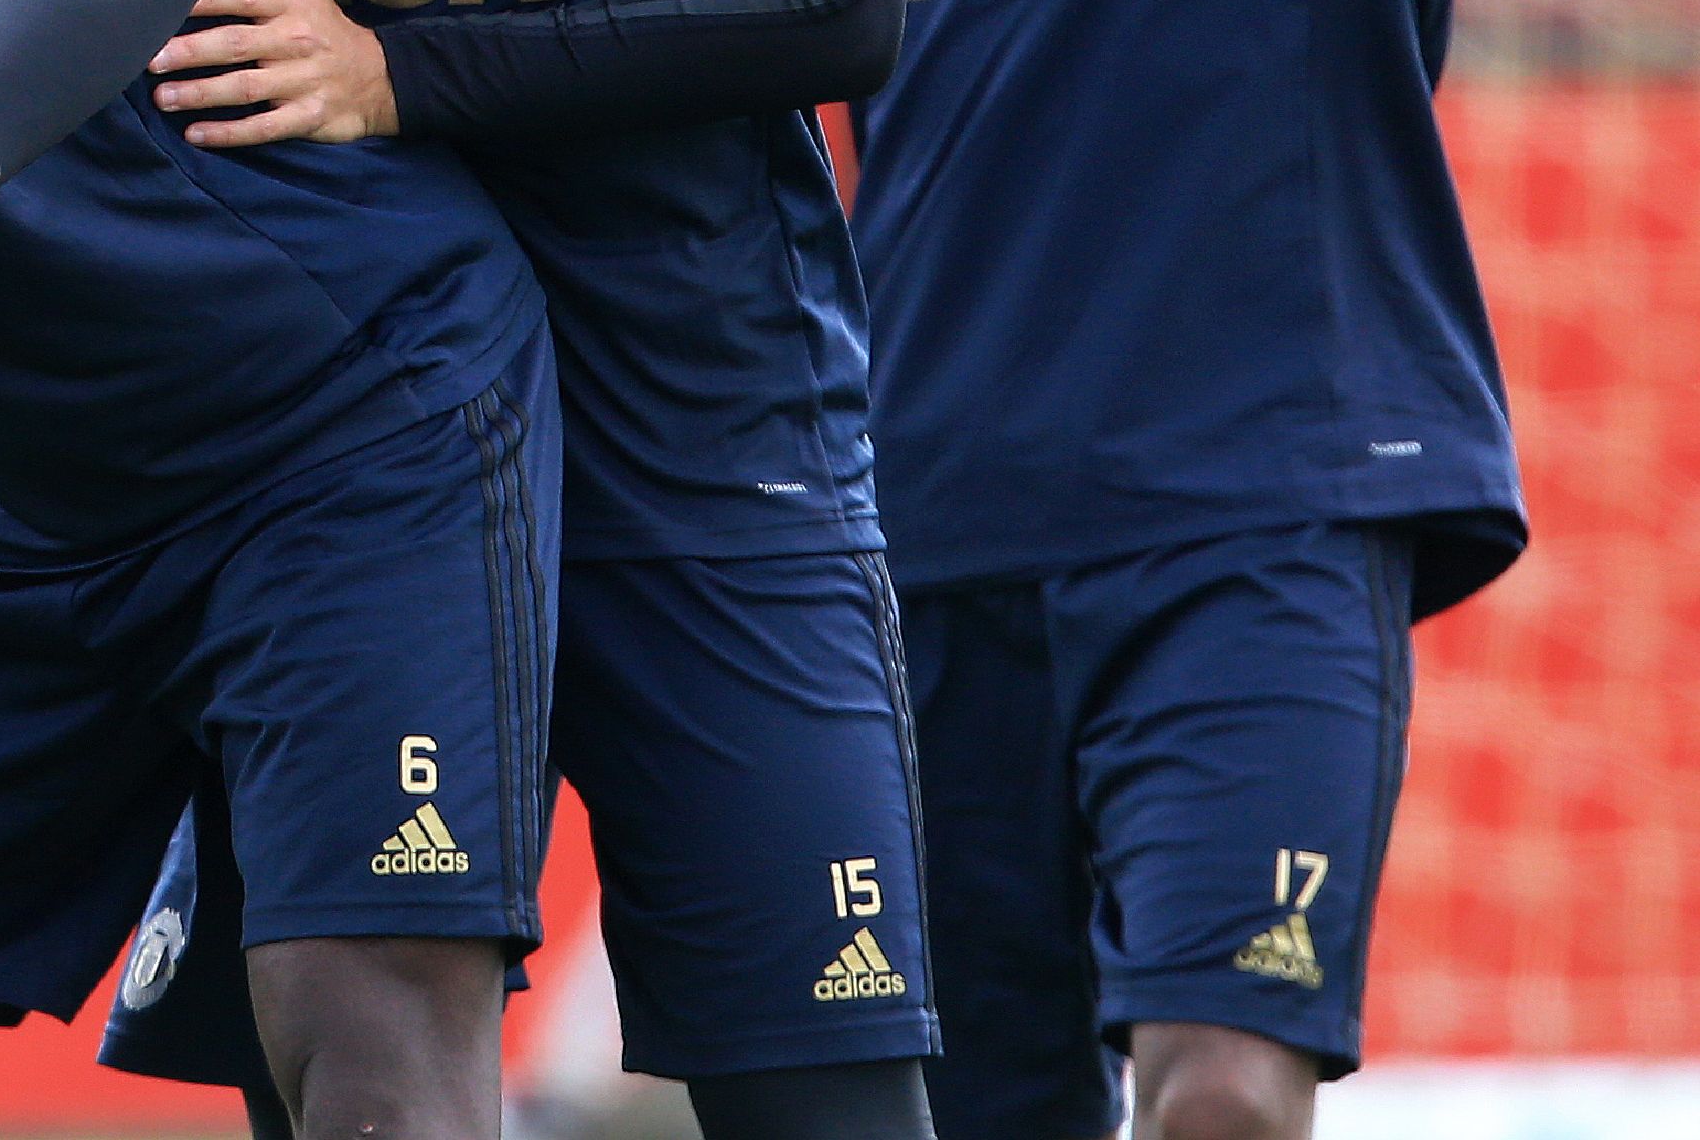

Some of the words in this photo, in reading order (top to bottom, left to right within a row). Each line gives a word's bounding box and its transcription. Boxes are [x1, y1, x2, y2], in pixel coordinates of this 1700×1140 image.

[401, 735, 439, 795] 6
[371, 845, 470, 876] adidas
[830, 857, 882, 918] 15
[1274, 848, 1329, 913] 17
[812, 970, 907, 1003] adidas
